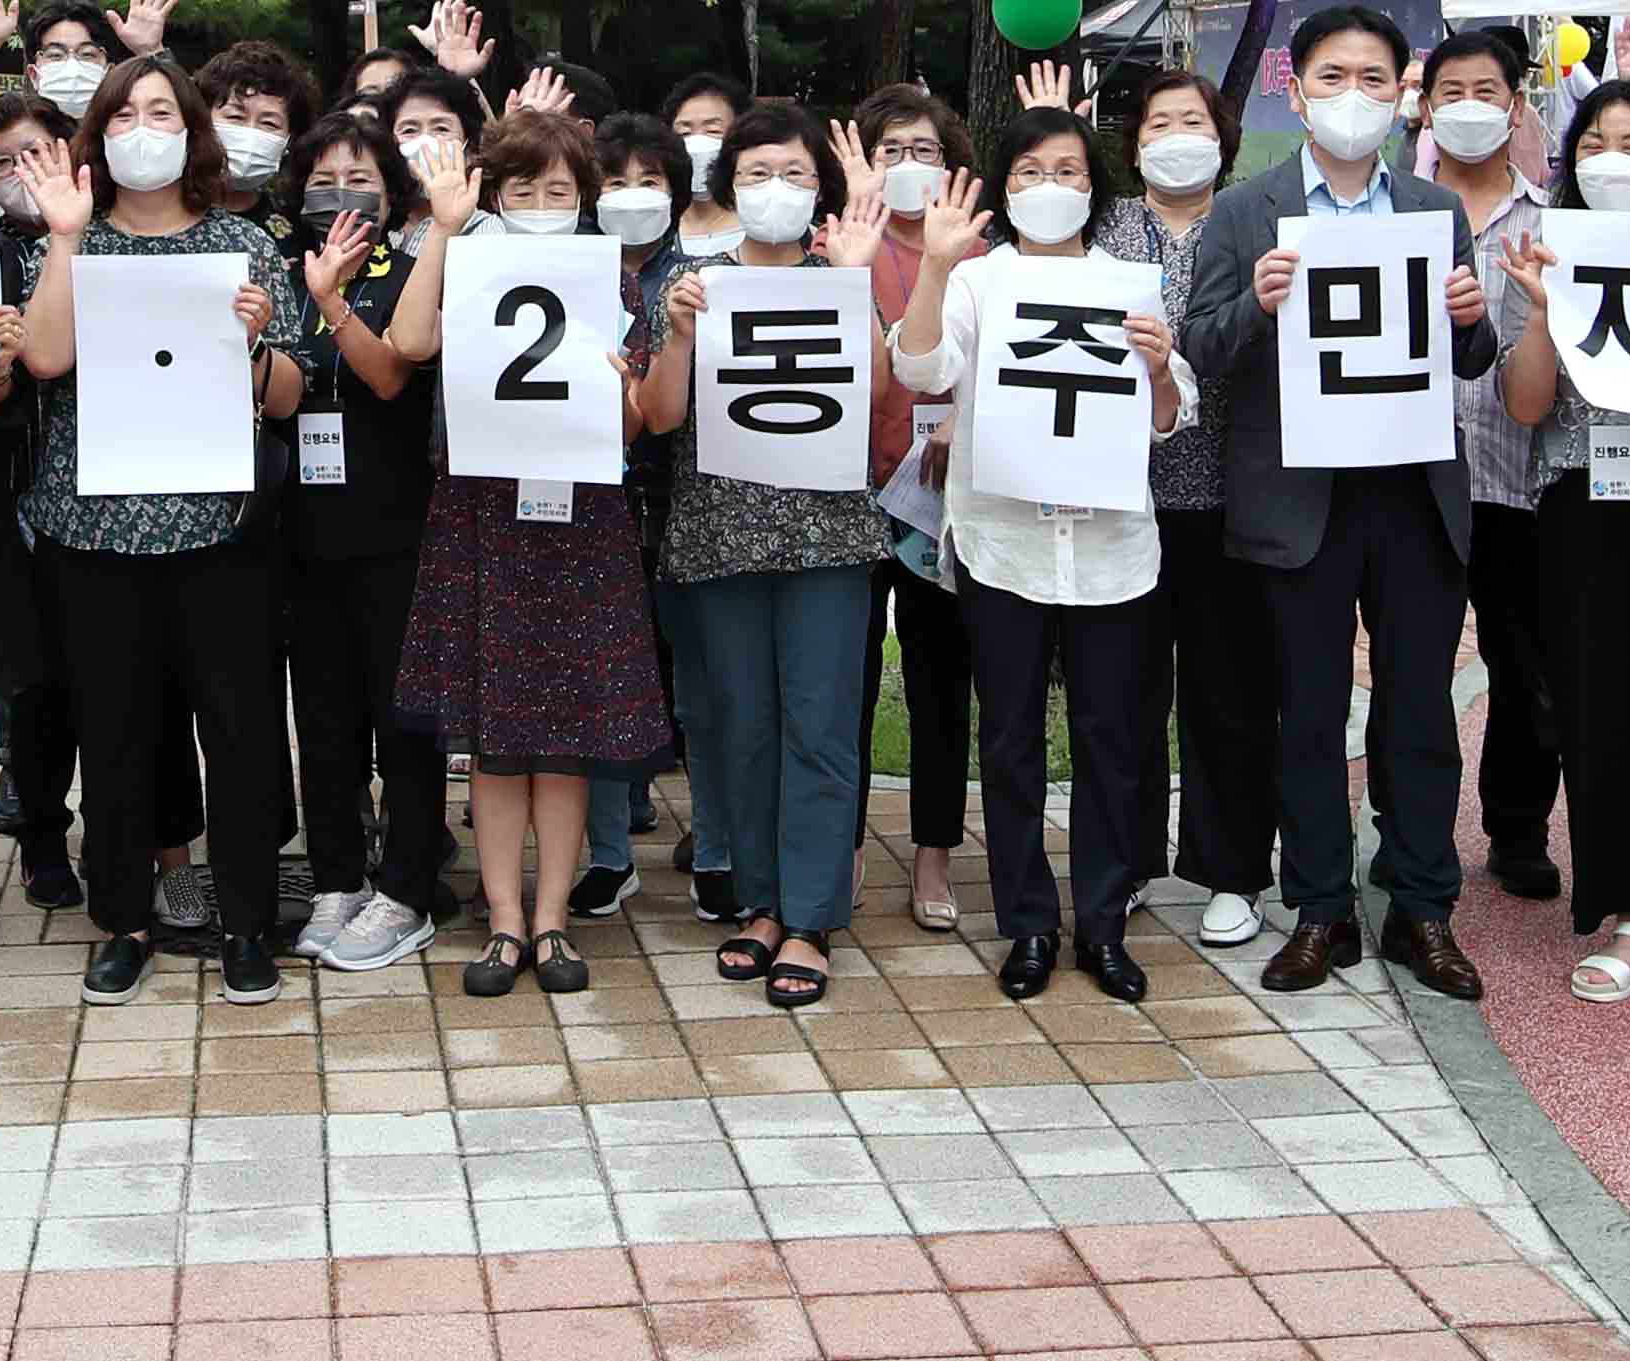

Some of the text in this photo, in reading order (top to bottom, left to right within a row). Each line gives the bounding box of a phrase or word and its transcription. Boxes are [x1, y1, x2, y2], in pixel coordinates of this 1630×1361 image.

[494, 285, 569, 401] 2
[716, 309, 854, 435] 동
[998, 302, 1137, 439] 주
[1307, 256, 1430, 396] 민
[301, 433, 340, 445] 진행요원
[916, 422, 943, 434] 진행
